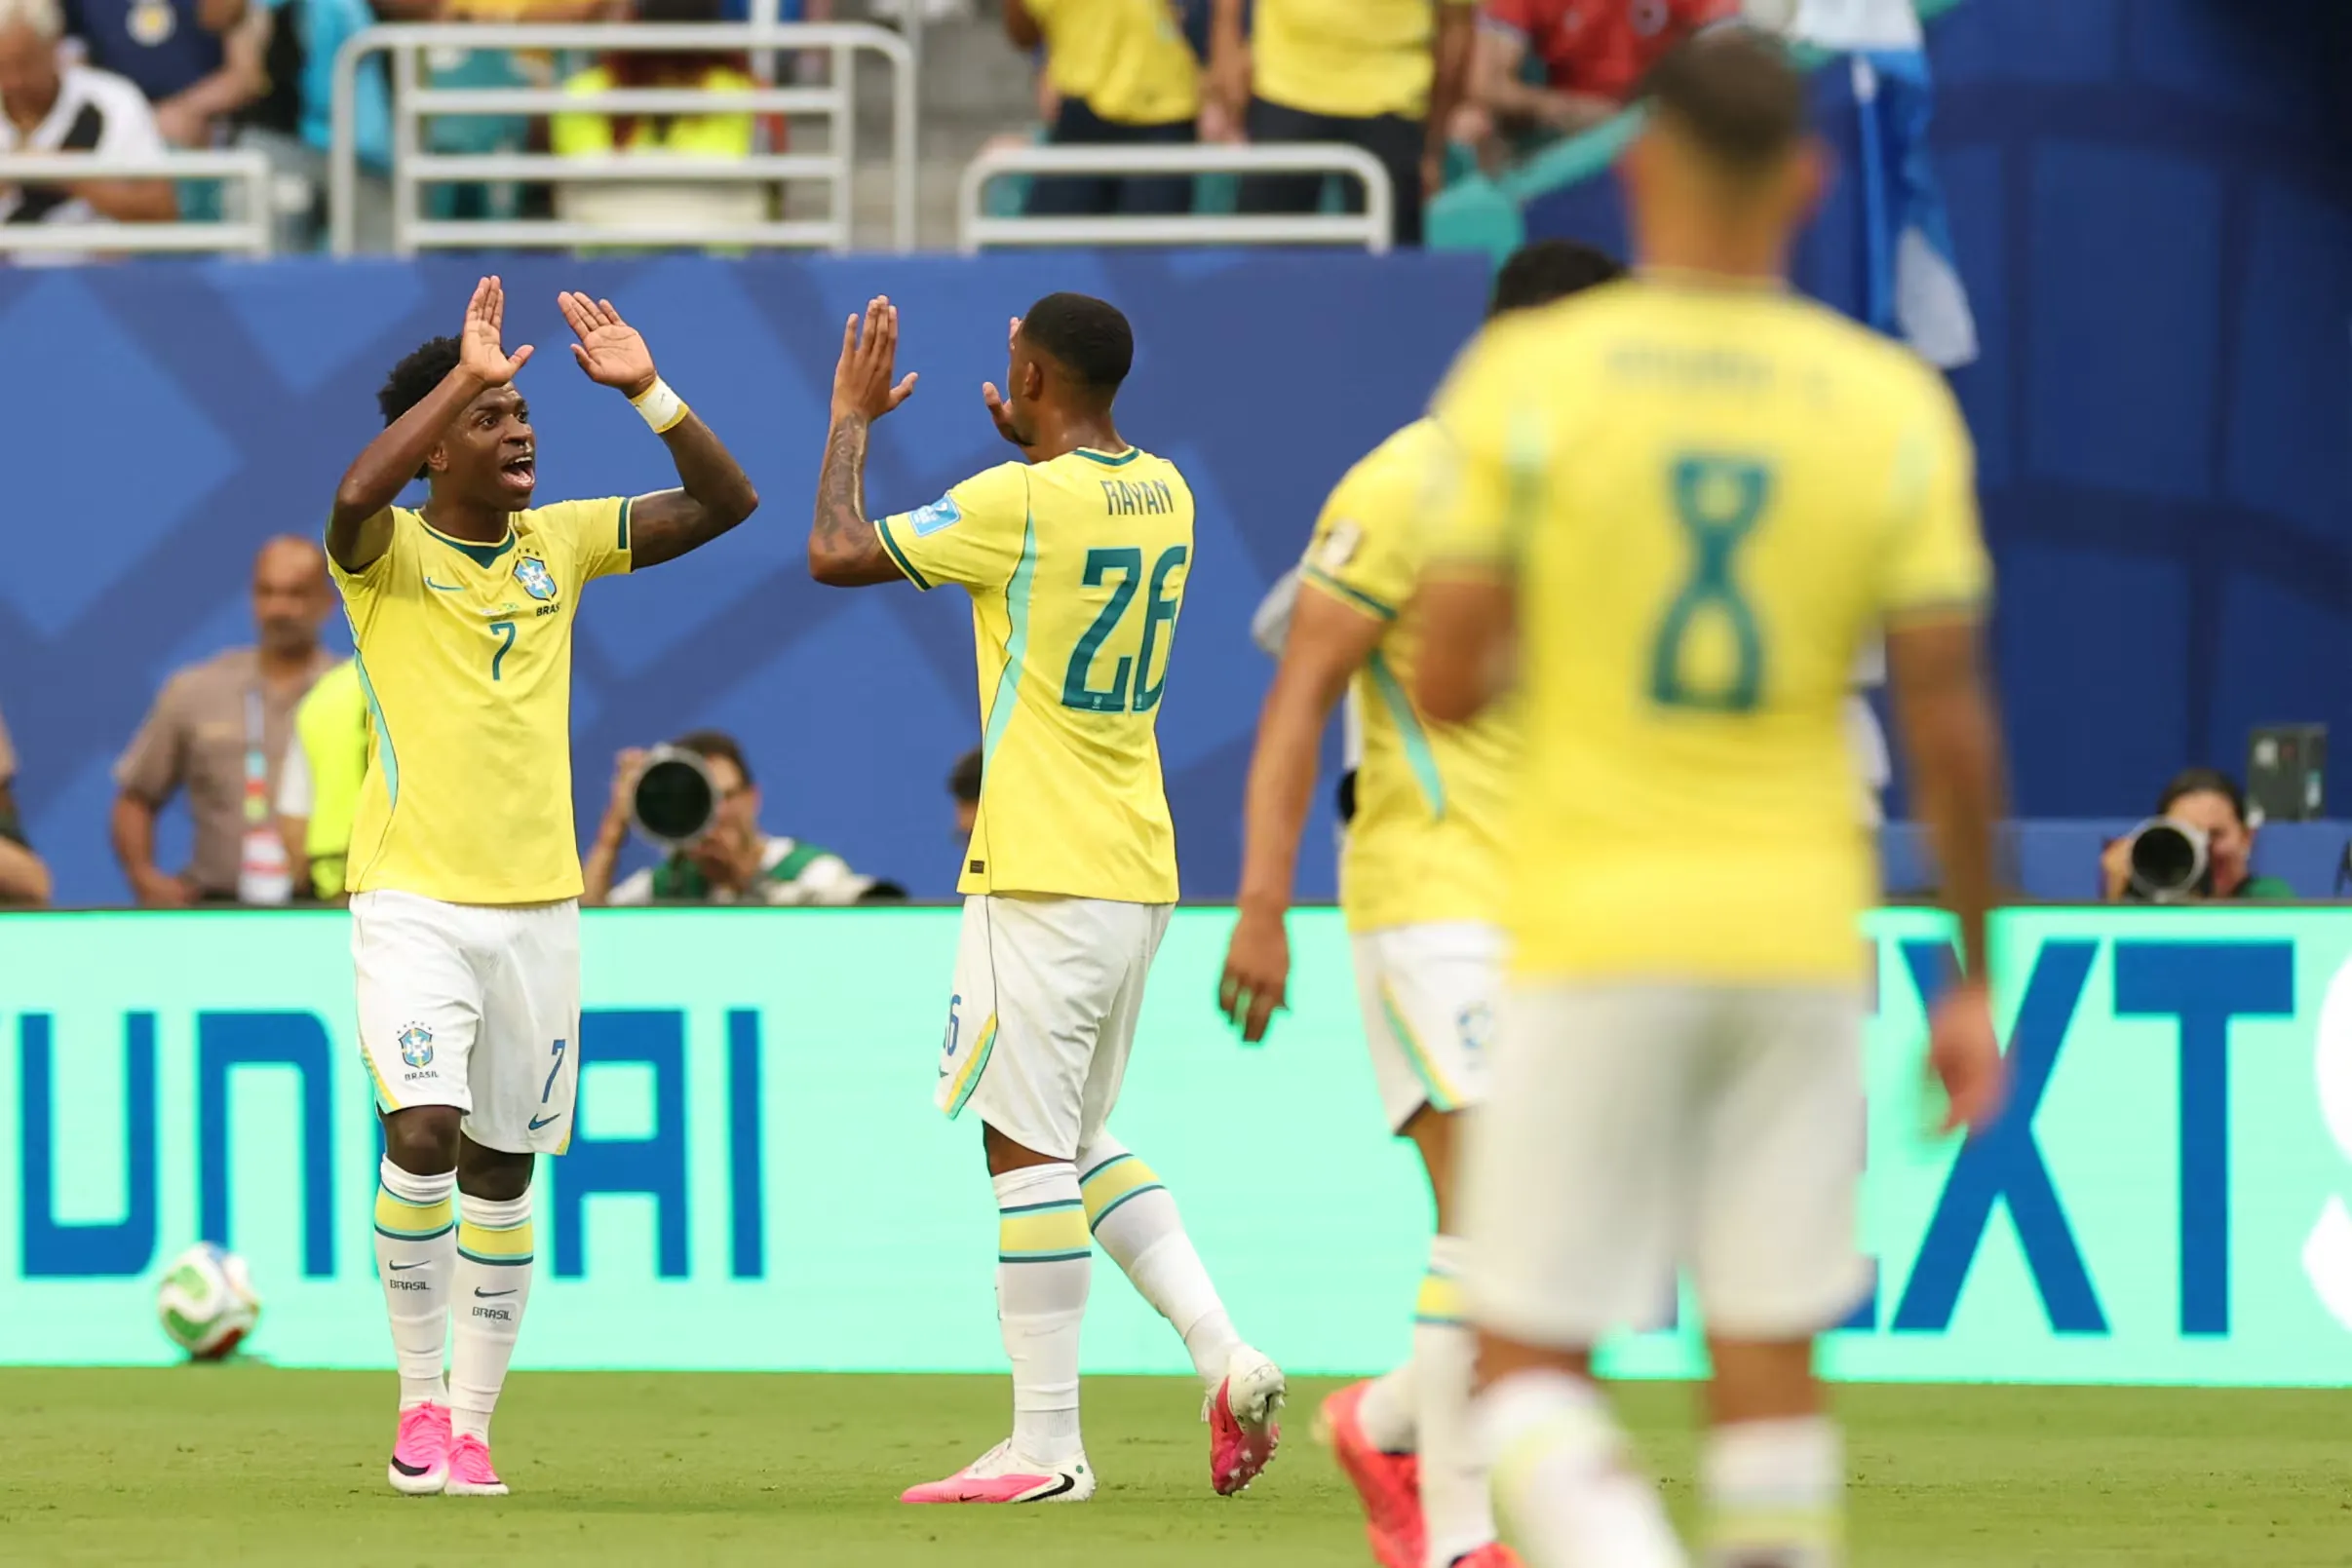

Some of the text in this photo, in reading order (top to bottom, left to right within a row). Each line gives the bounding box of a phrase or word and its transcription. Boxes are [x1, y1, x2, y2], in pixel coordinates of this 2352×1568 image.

[1099, 478, 1174, 516] RAYAN
[536, 601, 561, 617] BRAS
[1650, 451, 1770, 709] 8
[489, 622, 516, 681] 7
[1061, 546, 1187, 713] 26
[943, 993, 961, 1056] 6
[405, 1070, 439, 1081] BRASIL
[542, 1039, 566, 1103] 7
[21, 1011, 763, 1278] UNAI
[1831, 942, 2294, 1335] XT
[390, 1279, 431, 1290] BRASIL
[472, 1306, 512, 1320] BRASIL
